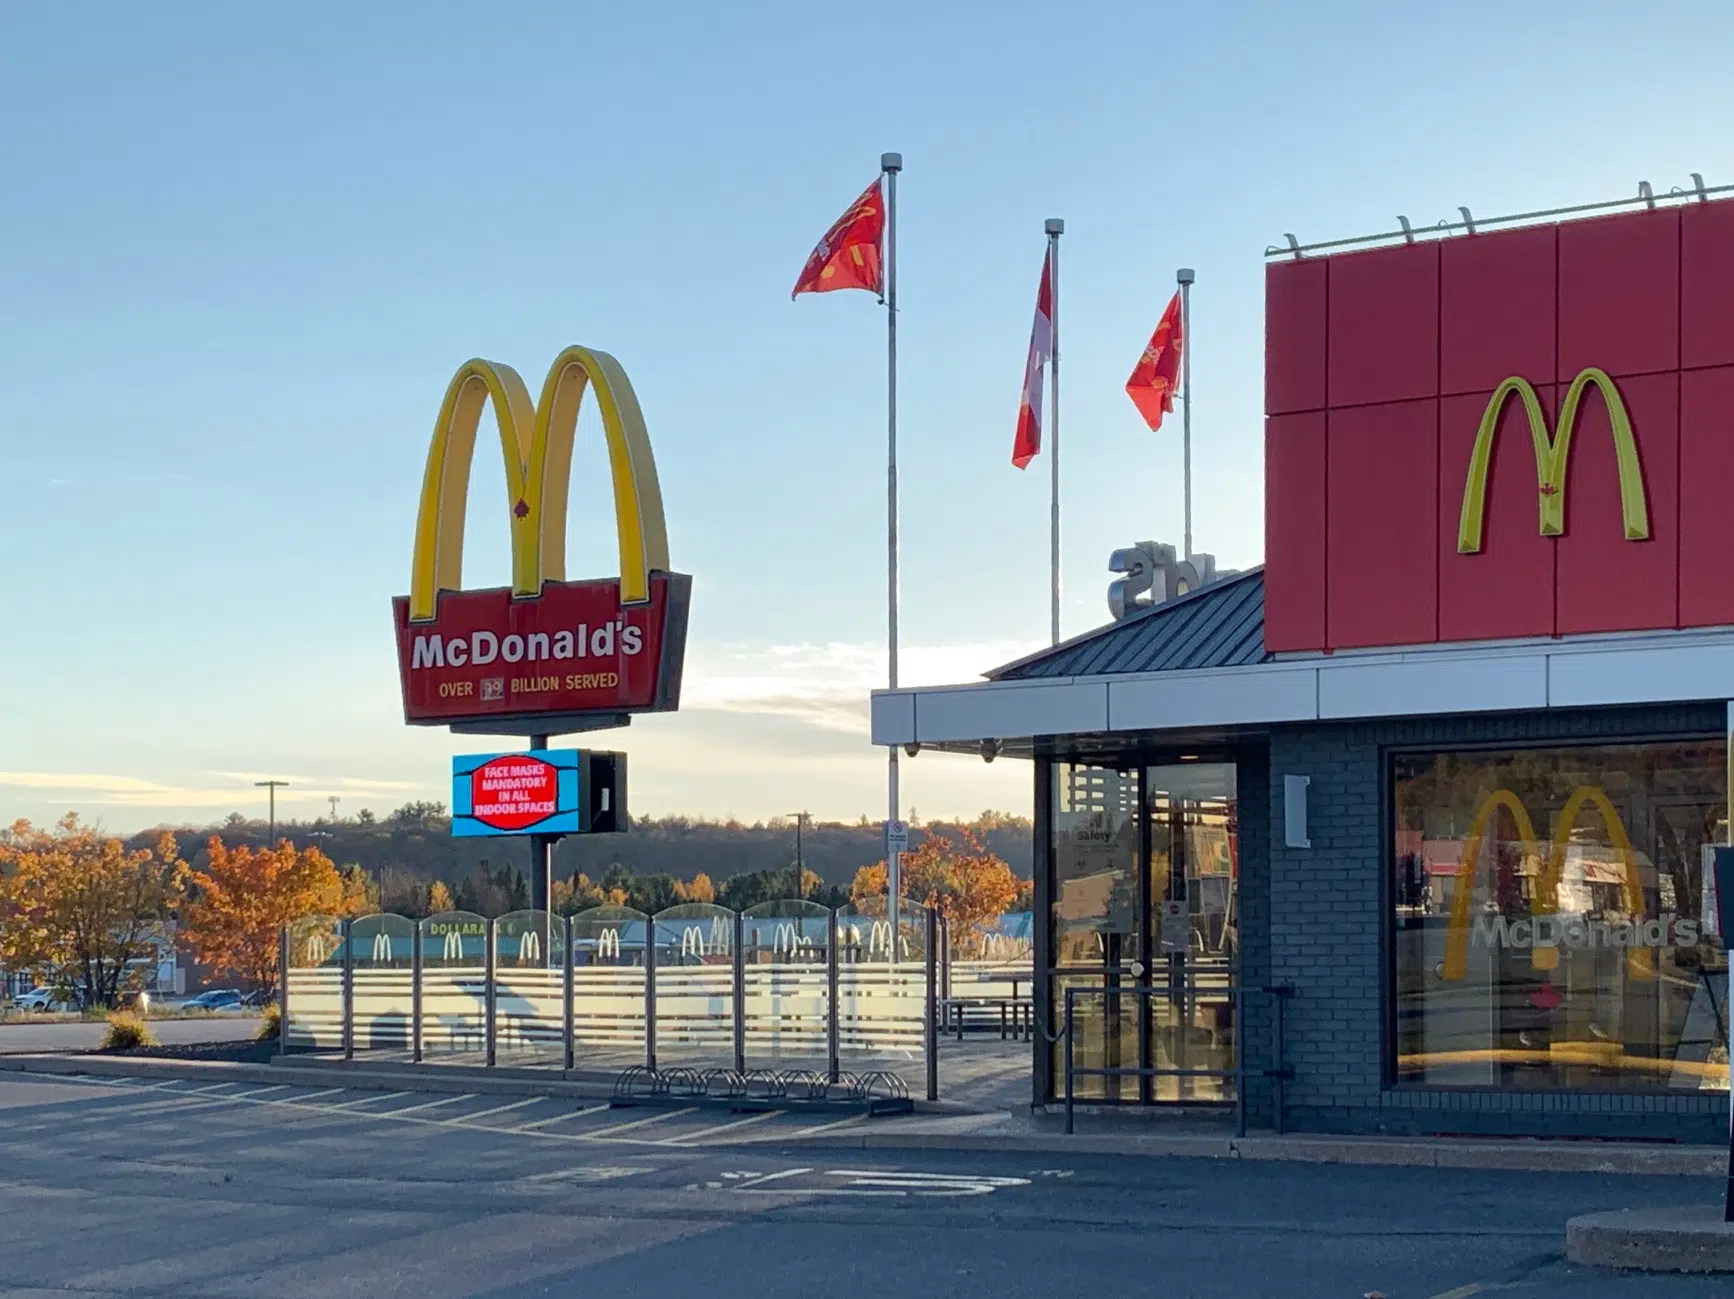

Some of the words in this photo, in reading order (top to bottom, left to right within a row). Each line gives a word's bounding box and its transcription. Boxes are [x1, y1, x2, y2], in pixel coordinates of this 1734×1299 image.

[412, 621, 643, 669] McDonald's
[440, 682, 473, 697] OVER
[511, 677, 559, 692] BILLION
[566, 673, 618, 689] SERVED
[485, 766, 509, 778] FACE
[510, 764, 545, 776] MASKS
[482, 776, 547, 790] MANDATORY
[499, 791, 510, 802] IN
[512, 790, 531, 802] ALL
[475, 804, 517, 816] INDOOR
[518, 801, 555, 814] SPACES
[1077, 831, 1111, 843] Safety
[1472, 913, 1698, 948] McDonald's
